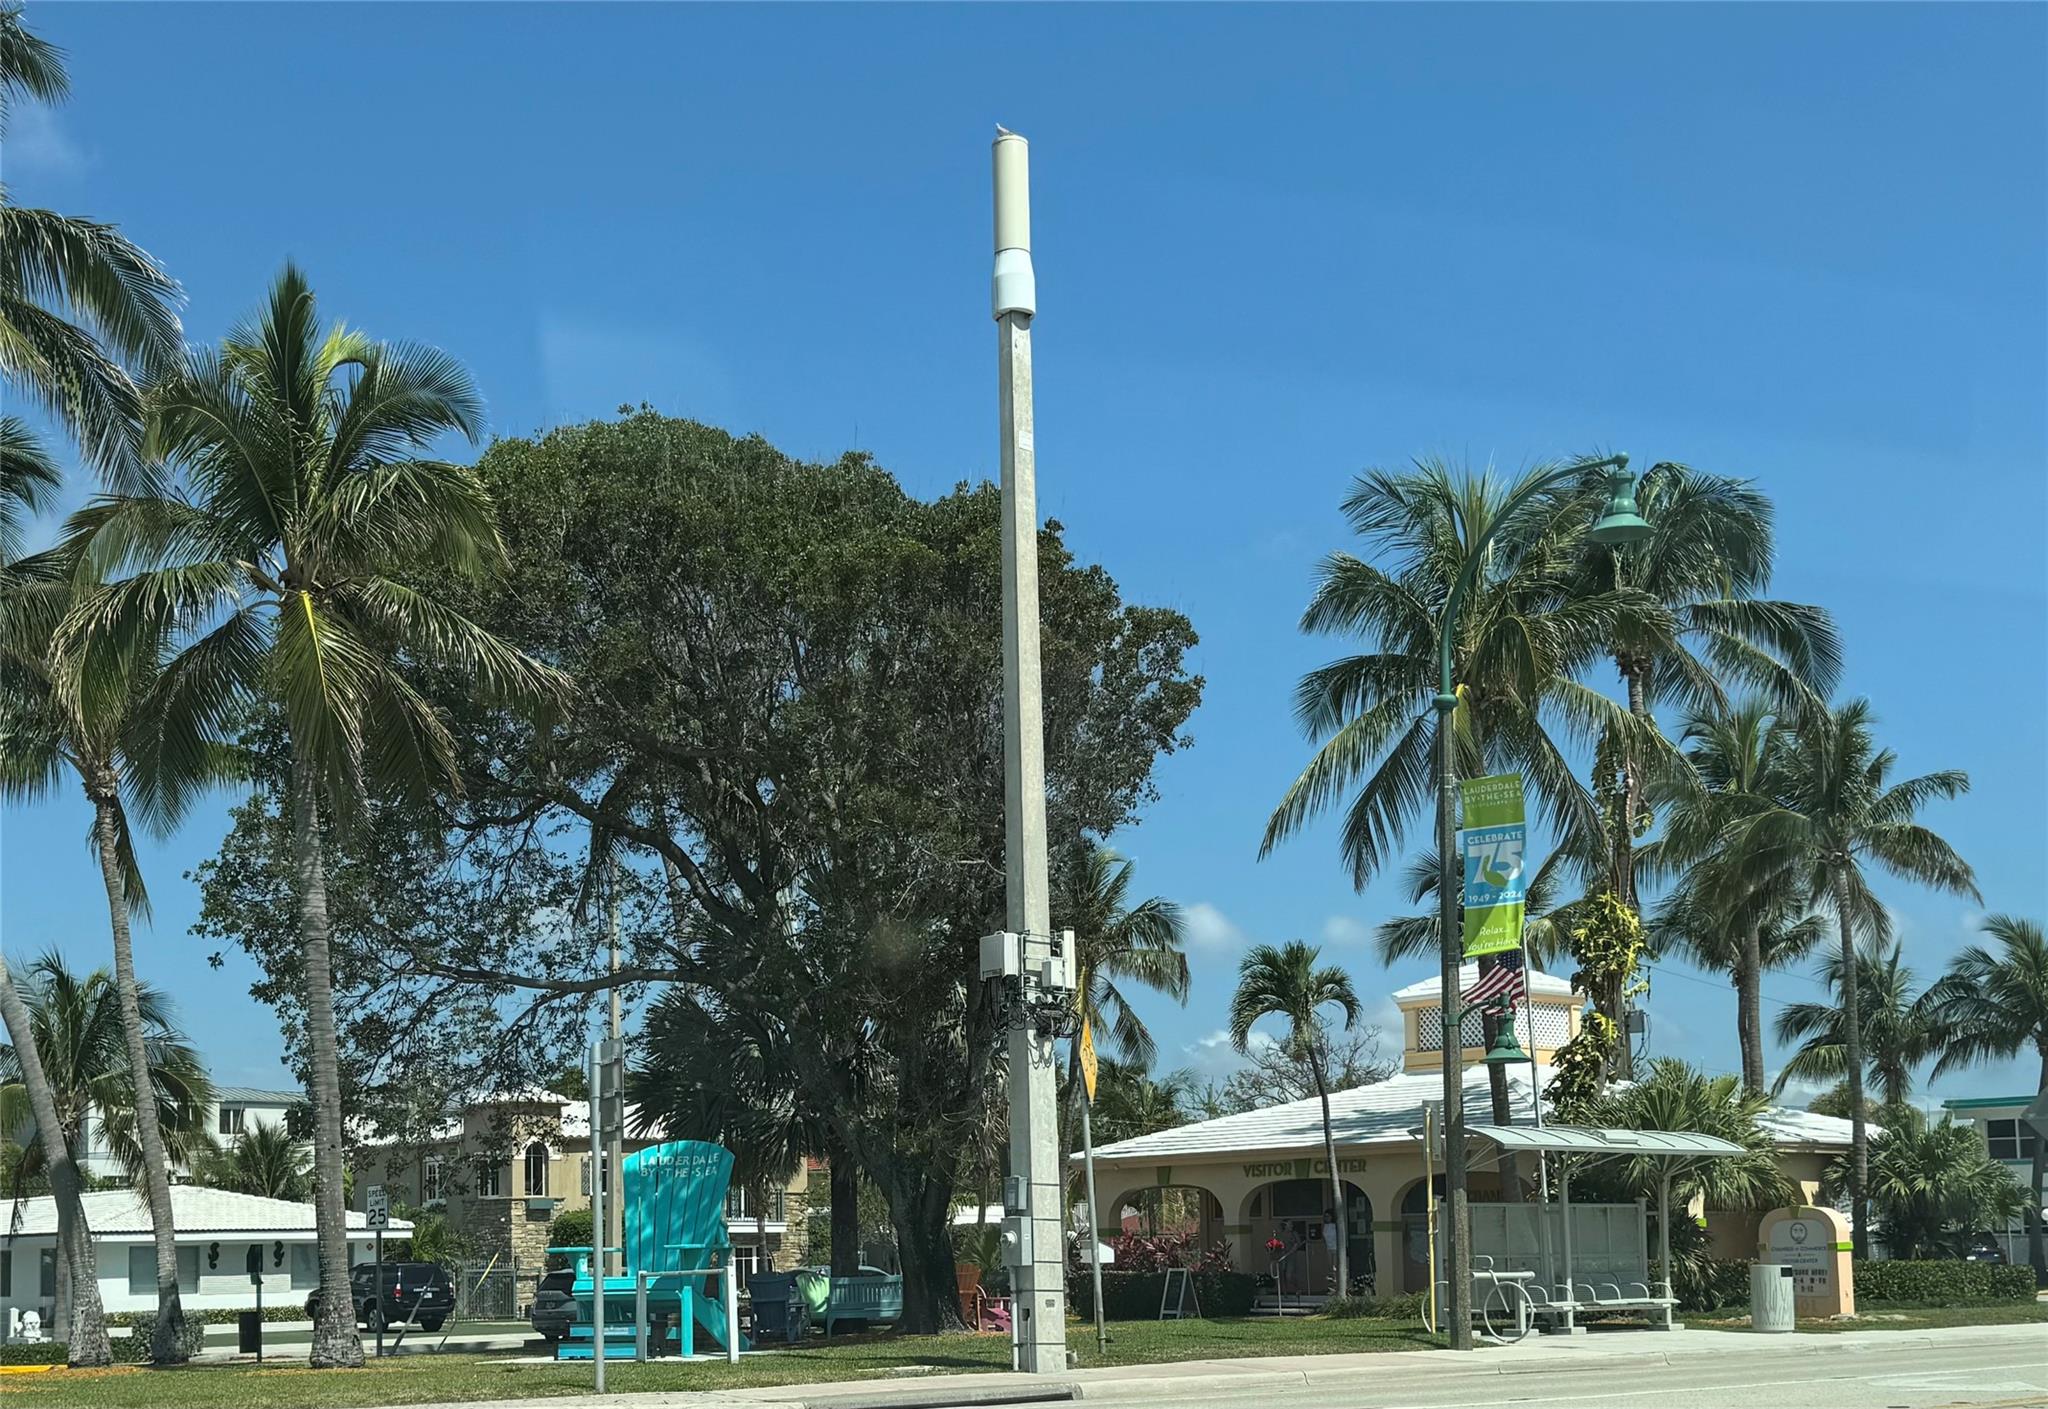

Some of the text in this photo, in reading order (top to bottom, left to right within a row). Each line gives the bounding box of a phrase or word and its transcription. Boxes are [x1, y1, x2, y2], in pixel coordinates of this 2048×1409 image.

[1464, 781, 1520, 795] LAUDERDALE
[1467, 831, 1522, 845] CELEBRATE
[1468, 842, 1524, 884] 75
[1469, 894, 1490, 903] 1949
[641, 1152, 720, 1166] LAUDERDALE
[1243, 1162, 1292, 1178] VISITOR
[368, 1190, 386, 1198] SPEED
[370, 1198, 384, 1206] LIMIT
[369, 1208, 386, 1225] 25
